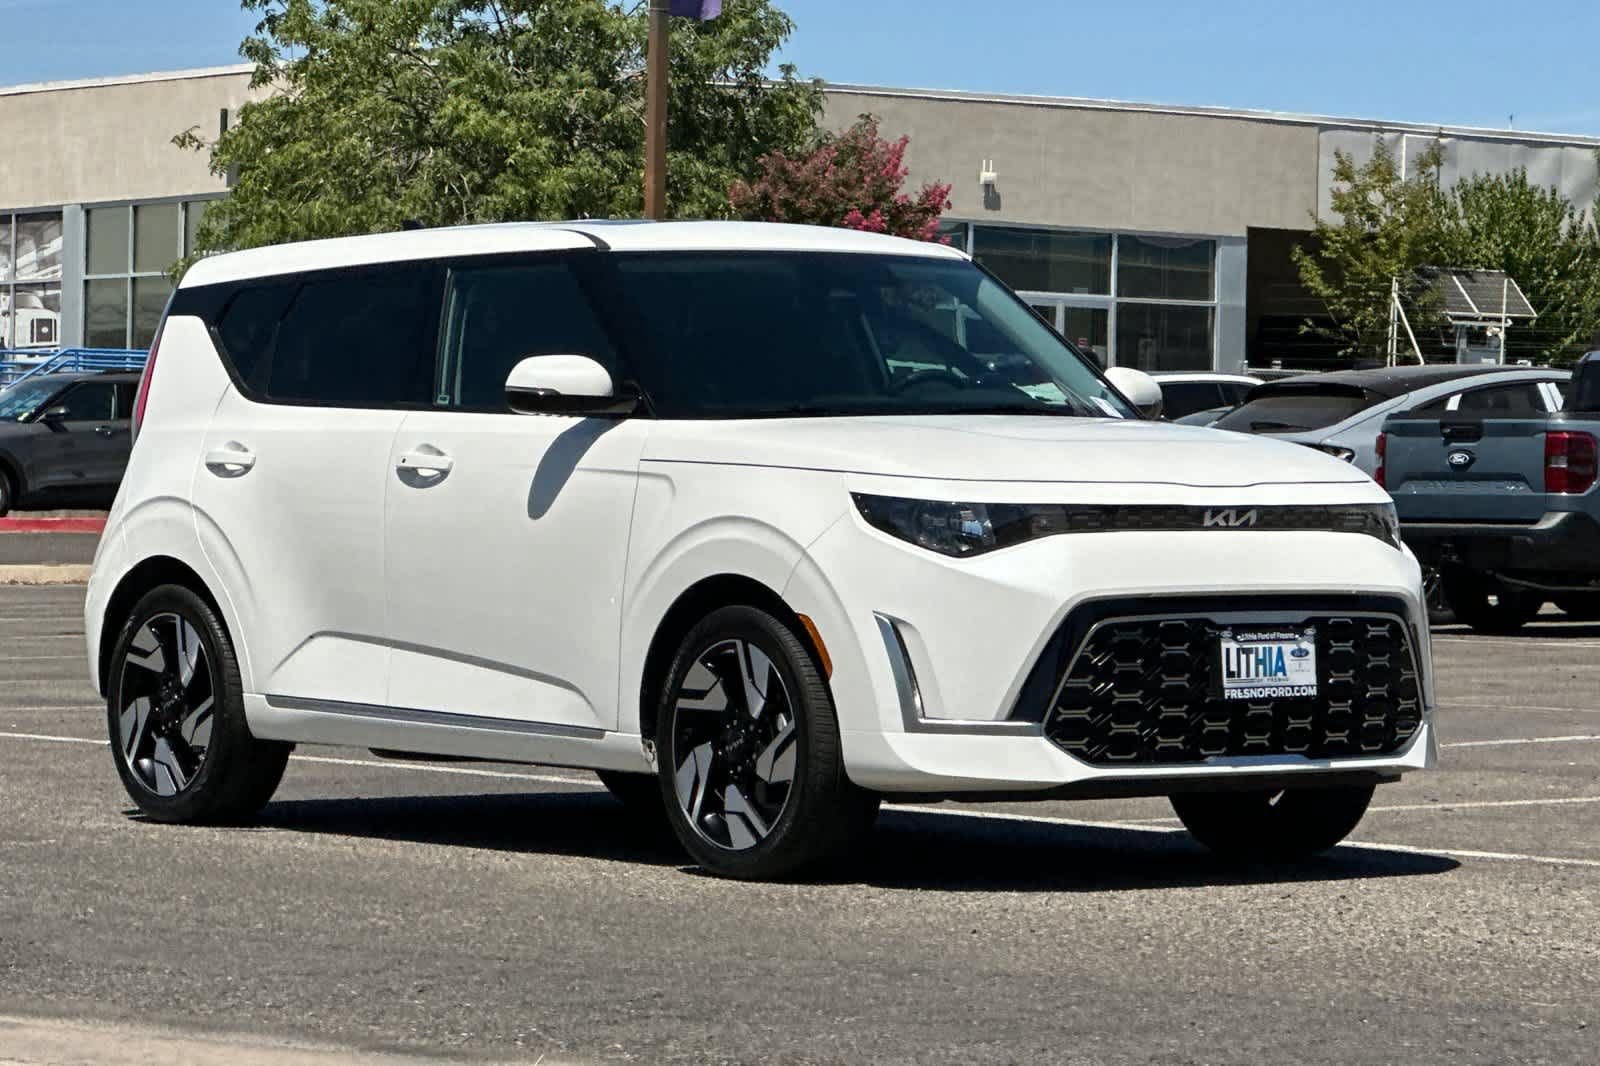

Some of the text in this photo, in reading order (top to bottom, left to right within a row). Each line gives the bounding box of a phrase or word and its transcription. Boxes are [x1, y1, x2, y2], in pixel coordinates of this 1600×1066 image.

[1203, 509, 1257, 527] KIA
[1225, 646, 1287, 679] LITHIA
[1224, 686, 1318, 700] FRESNOFORD.COM
